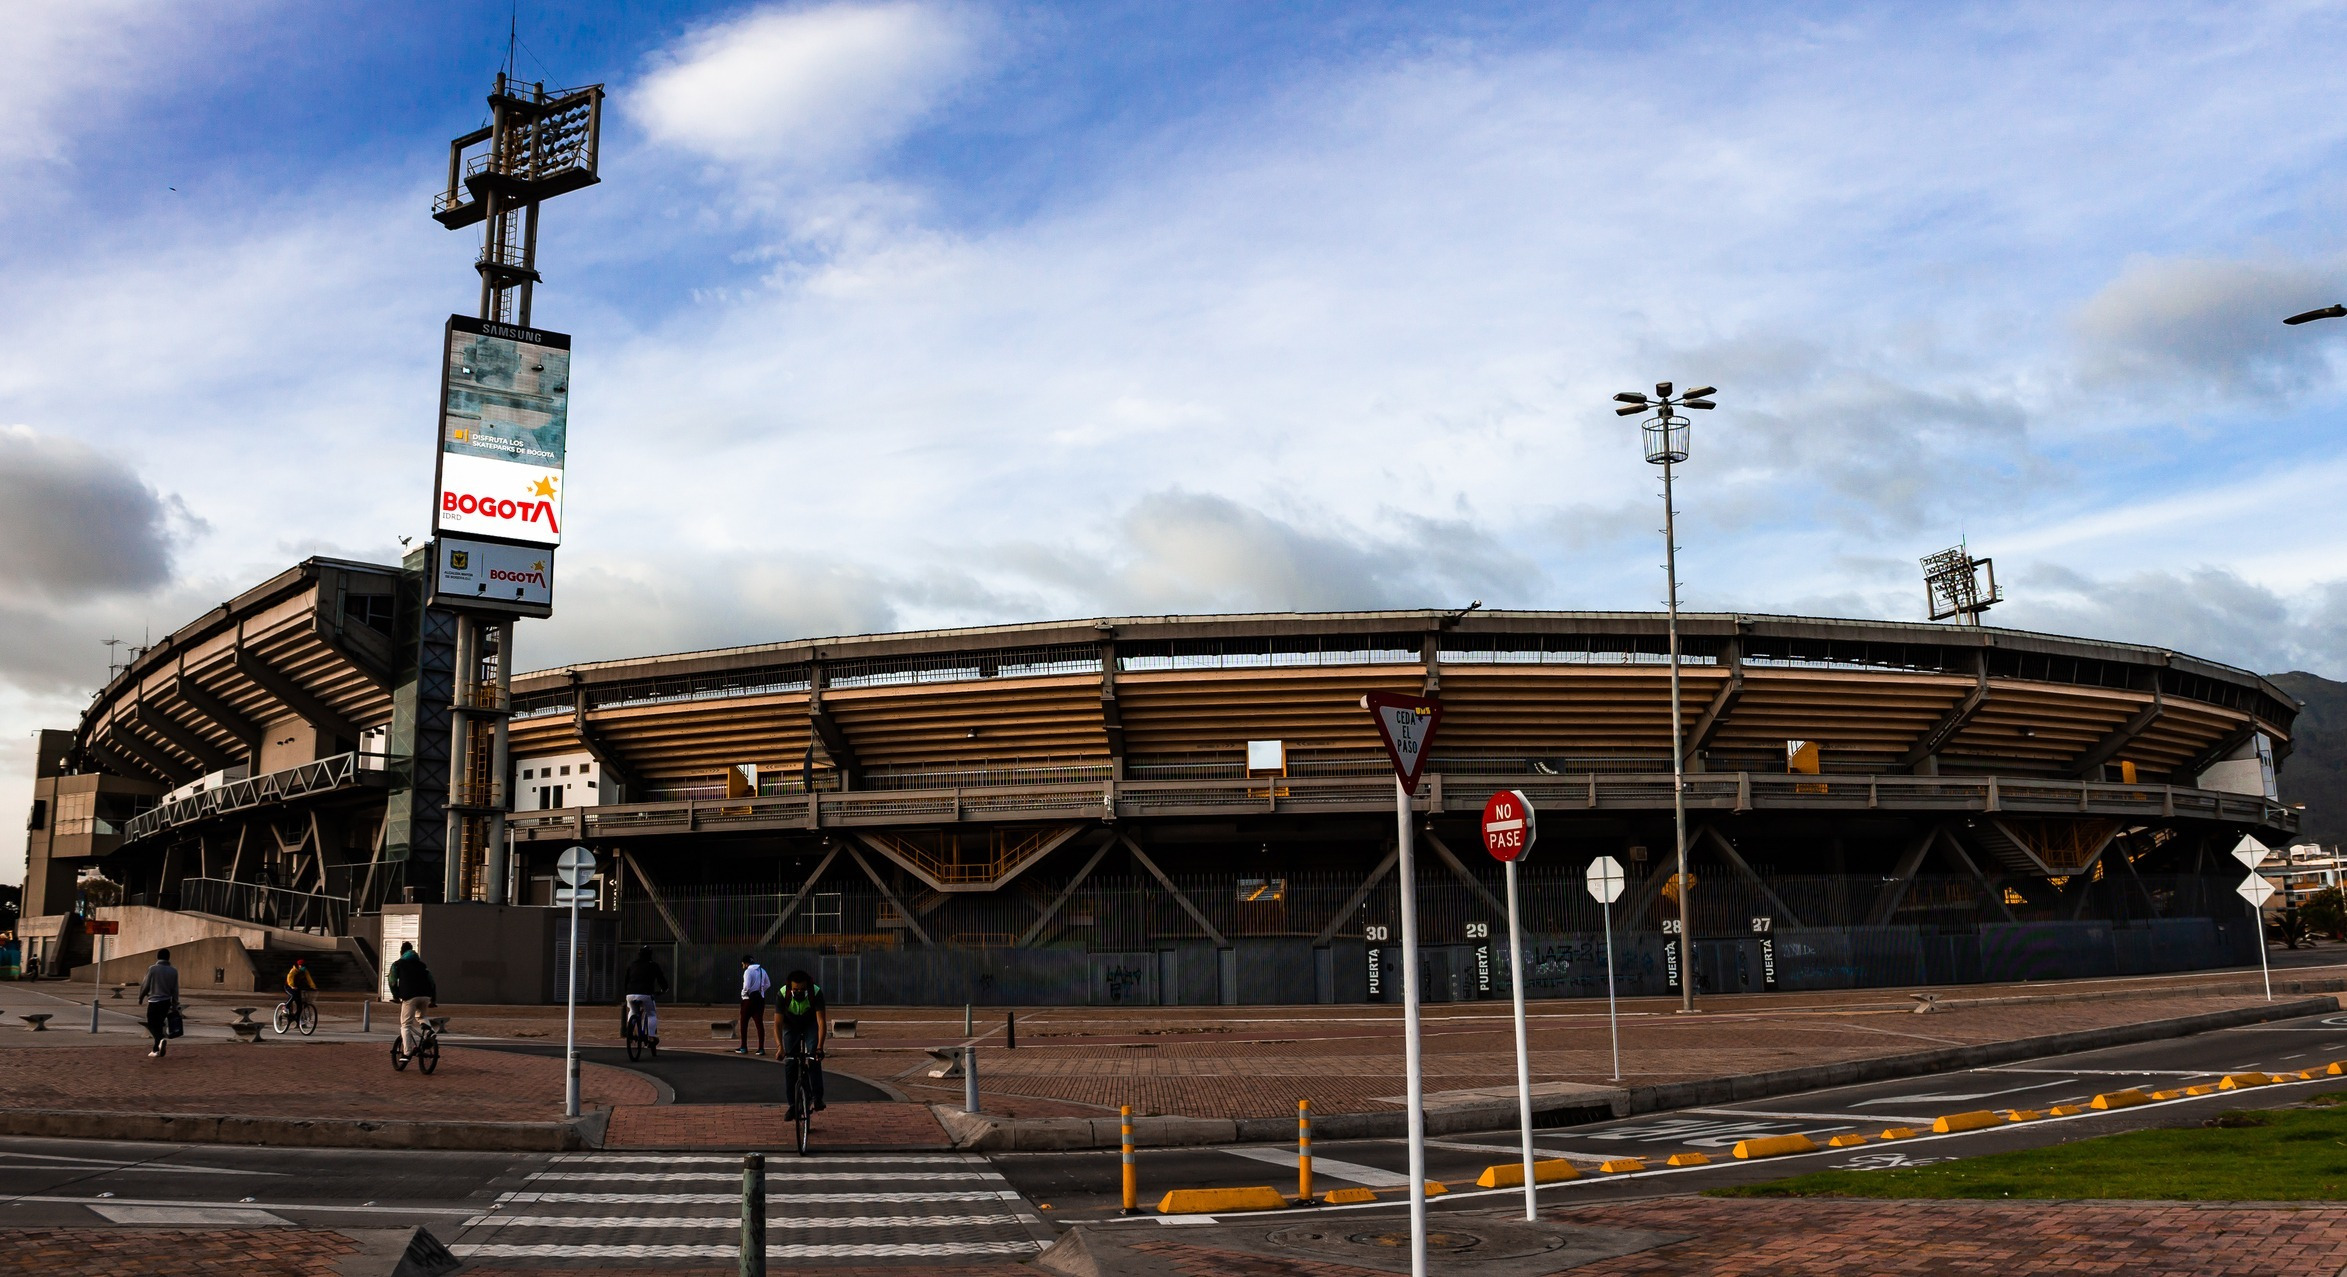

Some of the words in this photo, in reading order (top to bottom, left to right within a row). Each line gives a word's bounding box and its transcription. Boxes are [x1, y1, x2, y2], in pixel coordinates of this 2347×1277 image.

[482, 323, 542, 343] SAMSUNG
[472, 434, 508, 445] DISFRUTA
[509, 439, 524, 447] LOS
[472, 441, 515, 453] SKATEPARKS
[442, 512, 462, 521] IDRD
[1396, 710, 1416, 726] CEDA
[1402, 725, 1411, 740] EL
[1397, 739, 1418, 754] PASO
[1495, 803, 1512, 821] NO
[1489, 830, 1521, 849] PASE
[1466, 923, 1488, 938] 29
[1662, 919, 1682, 934] 28
[1752, 917, 1771, 932] 27
[1366, 926, 1388, 941] 30
[1476, 946, 1490, 991] PUERTA
[1666, 941, 1678, 987] PUERTA
[1763, 939, 1775, 983] PUERTA
[1368, 949, 1380, 994] PUERTA
[1533, 1119, 1857, 1148] PARE
